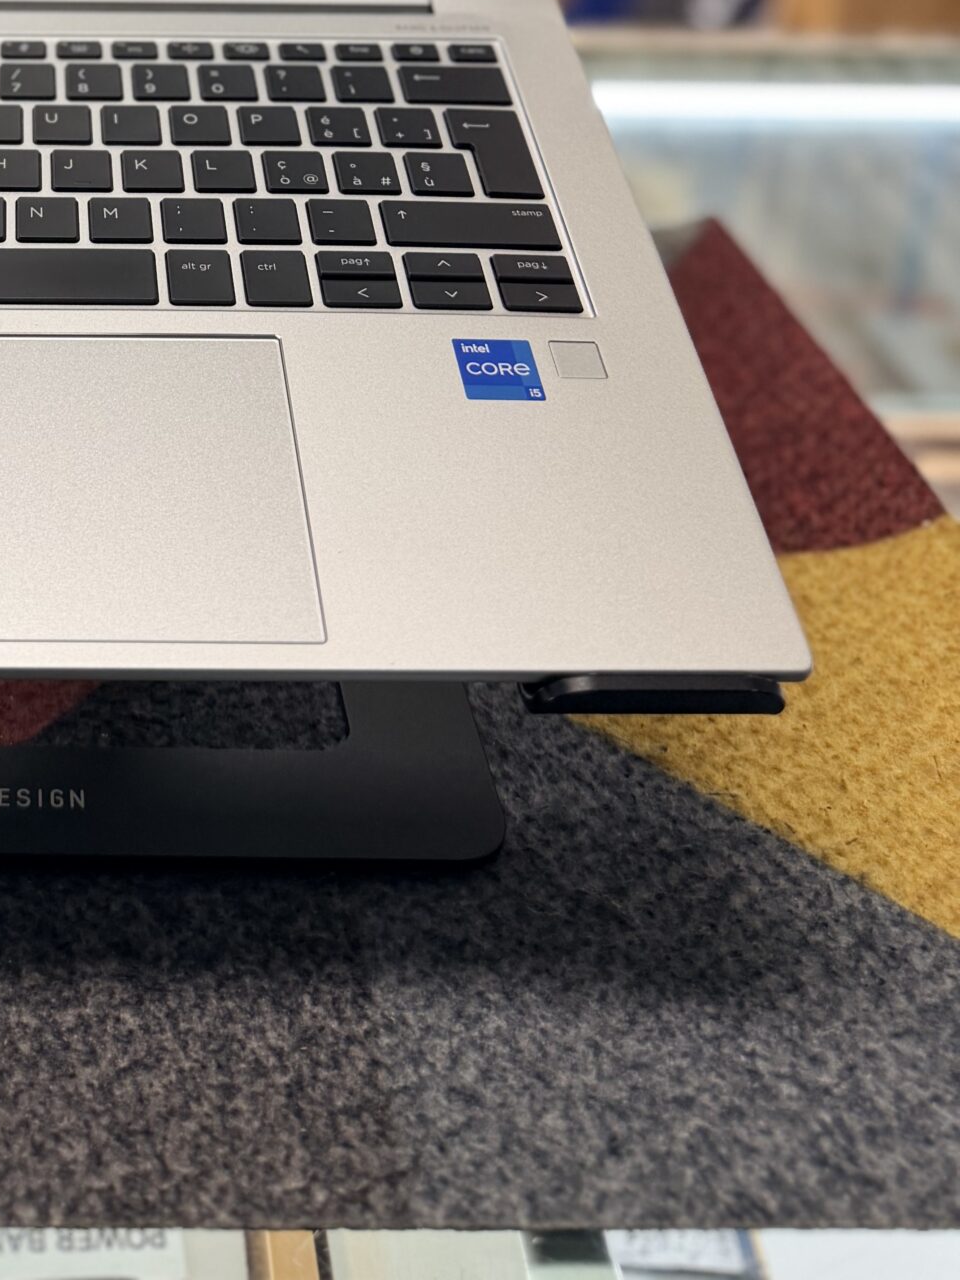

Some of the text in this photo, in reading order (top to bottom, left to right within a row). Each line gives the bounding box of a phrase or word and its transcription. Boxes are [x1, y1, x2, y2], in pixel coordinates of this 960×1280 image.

[11, 81, 22, 93] 7
[77, 82, 89, 94] 8
[144, 82, 157, 94] 9
[44, 112, 59, 124] U
[182, 113, 199, 125] O
[250, 113, 263, 125] P
[63, 158, 73, 170] J
[134, 159, 148, 170] K
[205, 159, 217, 171] L
[302, 173, 319, 185] @
[380, 176, 392, 186] #
[30, 206, 44, 218] N
[103, 207, 119, 219] M
[511, 209, 544, 218] stamp
[181, 262, 212, 272] alt gr
[257, 263, 277, 271] ctrl
[340, 258, 363, 266] pag
[516, 261, 540, 270] pag
[460, 343, 490, 354] intel
[529, 388, 542, 398] i5
[56, 1227, 167, 1252] POWER
